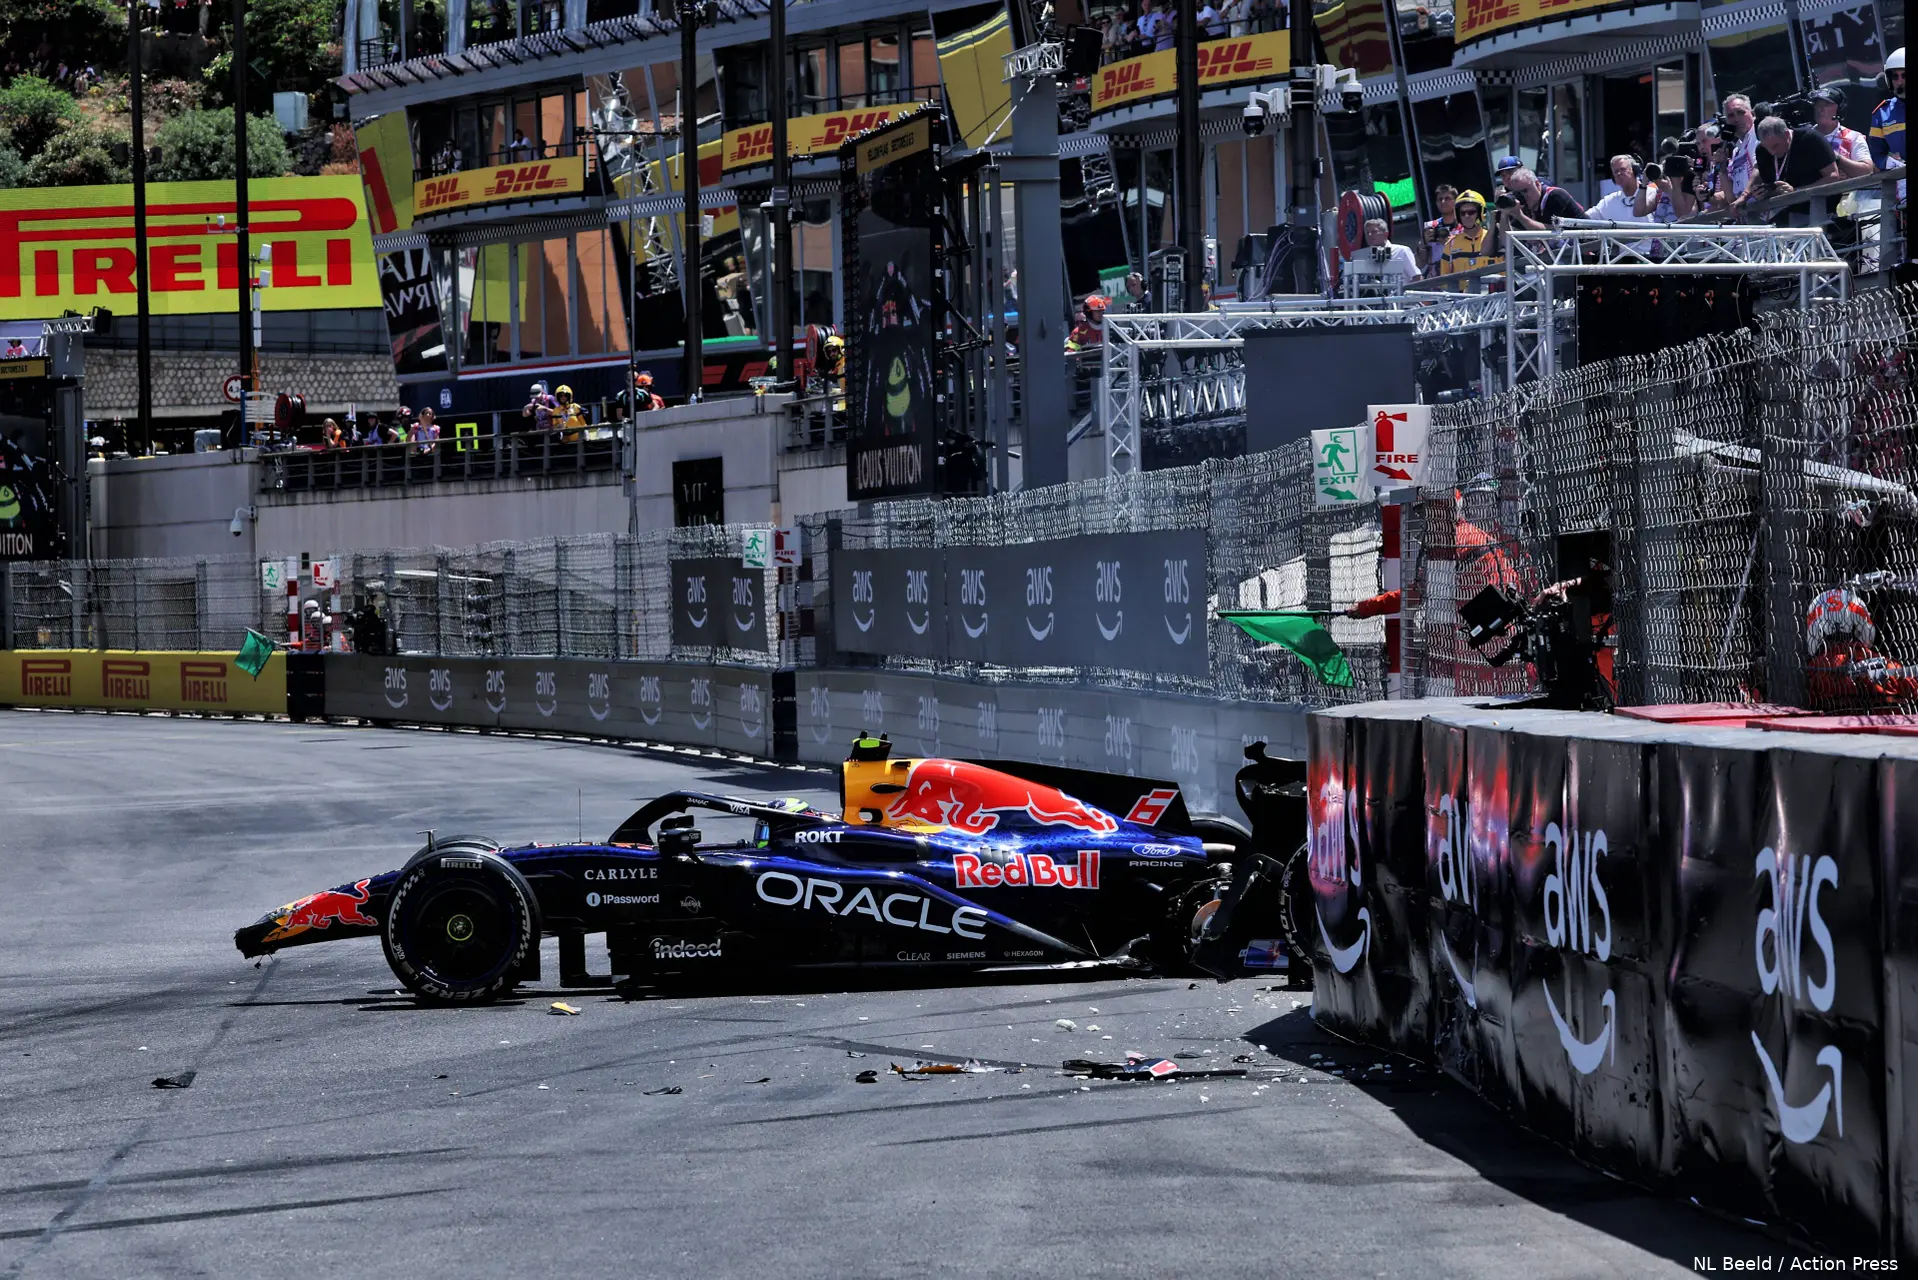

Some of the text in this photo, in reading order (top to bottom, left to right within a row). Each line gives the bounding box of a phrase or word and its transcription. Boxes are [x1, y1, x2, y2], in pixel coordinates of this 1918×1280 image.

[1101, 62, 1151, 100] DHL
[423, 177, 466, 208] DHL
[490, 164, 561, 196] DHL
[0, 197, 357, 297] PIRELLI
[857, 444, 922, 490] LOUIS VUITTON
[1375, 454, 1419, 464] FIRE
[1319, 475, 1358, 486] EXIT
[0, 532, 33, 556] ITTON
[687, 575, 706, 604] aws
[732, 577, 753, 607] aws
[852, 569, 873, 603] aws
[906, 569, 928, 604] aws
[961, 568, 986, 607] aws
[1026, 565, 1053, 607] aws
[1096, 560, 1122, 603] aws
[1164, 558, 1190, 604] aws
[21, 659, 72, 697] PIRELLI
[102, 660, 150, 700] PIRELLI
[180, 661, 228, 703] PIRELLI
[384, 667, 407, 691] aws
[429, 669, 452, 692] aws
[486, 670, 505, 694] aws
[535, 671, 556, 697] aws
[588, 673, 610, 700] aws
[640, 676, 661, 703] aws
[690, 678, 711, 706] aws
[740, 682, 761, 712] aws
[811, 687, 830, 718] aws
[863, 689, 884, 725] aws
[918, 696, 940, 732] aws
[977, 702, 998, 738] aw
[1037, 707, 1064, 748] aws
[1105, 714, 1132, 760] aws
[1171, 724, 1199, 775] aws
[729, 803, 751, 815] VISA
[1124, 788, 1180, 827] 6
[794, 830, 845, 844] ROKT
[1141, 844, 1171, 856] Ford
[440, 857, 483, 870] PIRELLI
[584, 867, 658, 881] CARLYLE
[953, 850, 1101, 890] Red Bull
[1129, 860, 1184, 868] RACING
[602, 893, 660, 905] 1Password
[756, 870, 988, 940] ORACLE
[1544, 821, 1612, 962] aws
[1755, 846, 1839, 1012] aws
[651, 938, 722, 960] indeed
[946, 951, 986, 960] SIEMENS
